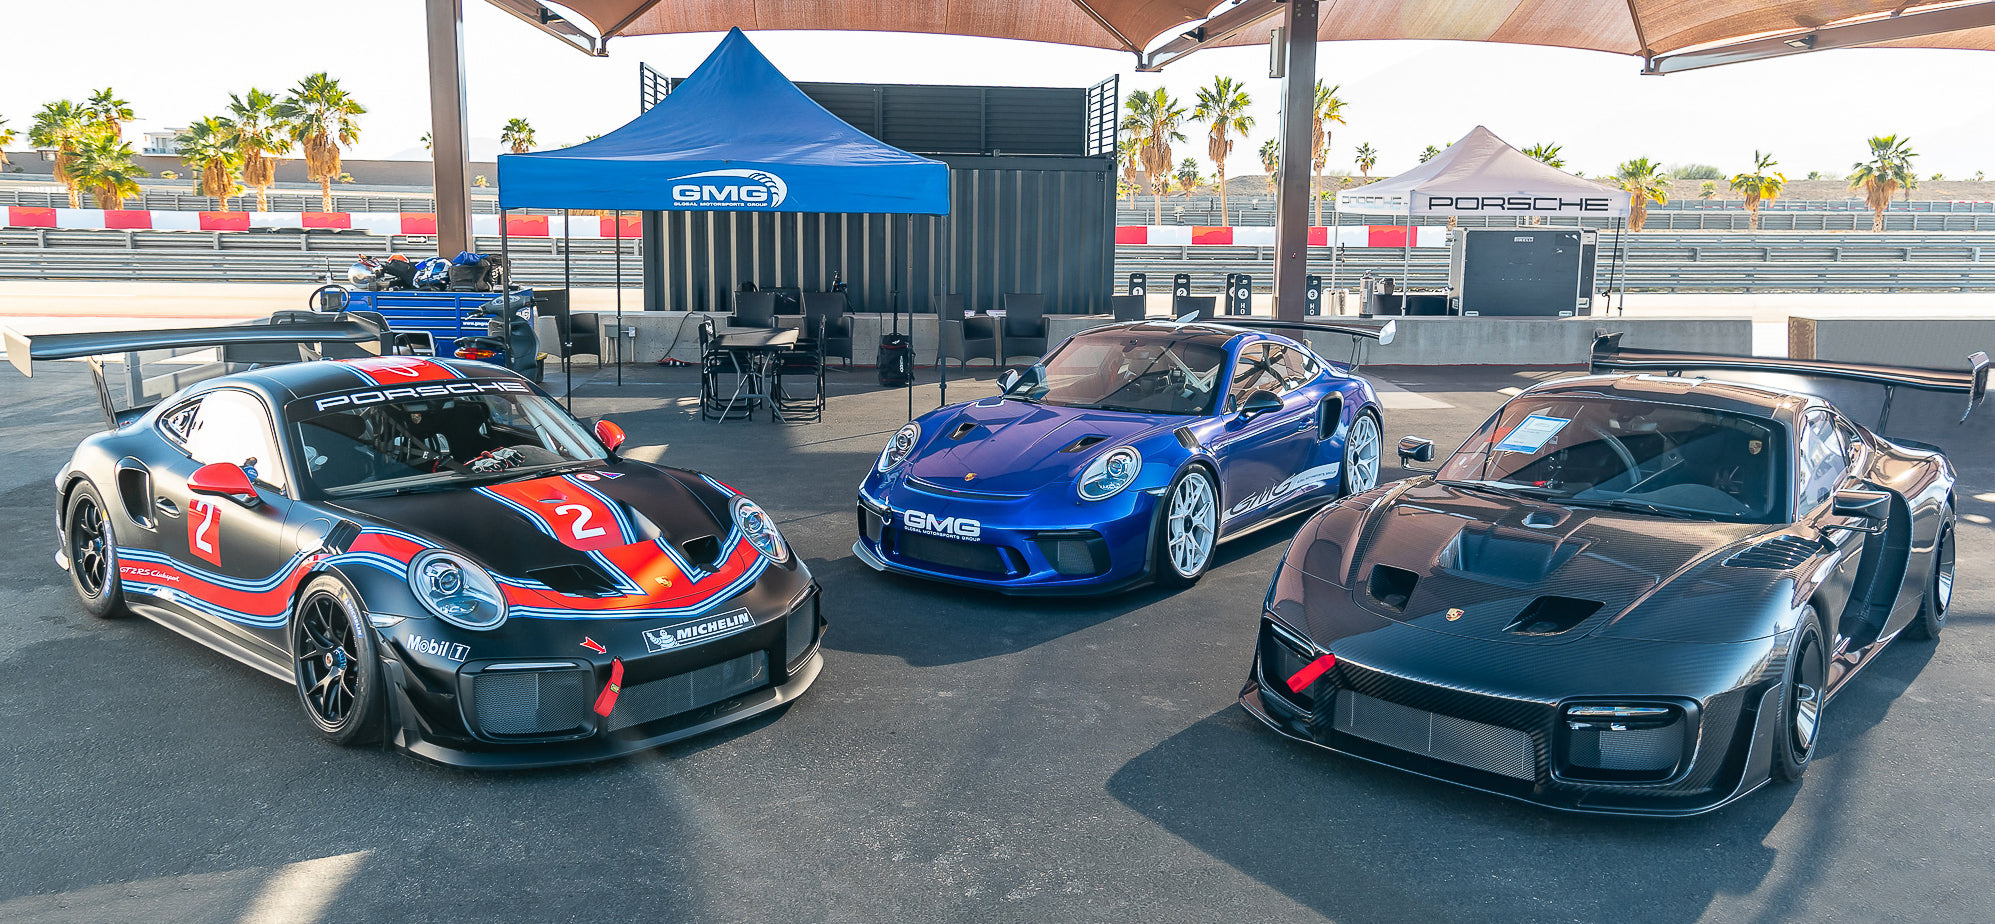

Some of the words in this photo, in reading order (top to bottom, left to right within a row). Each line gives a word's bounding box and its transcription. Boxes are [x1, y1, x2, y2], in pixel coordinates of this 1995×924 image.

[672, 185, 768, 202] GMG
[1428, 196, 1609, 211] PORSCHE
[316, 382, 530, 411] PORSCHE
[195, 500, 213, 554] 2
[554, 504, 607, 540] 2
[903, 509, 981, 537] GMG
[151, 569, 180, 582] Clubsport
[676, 613, 749, 640] MICHELIN
[406, 634, 449, 657] Mobil
